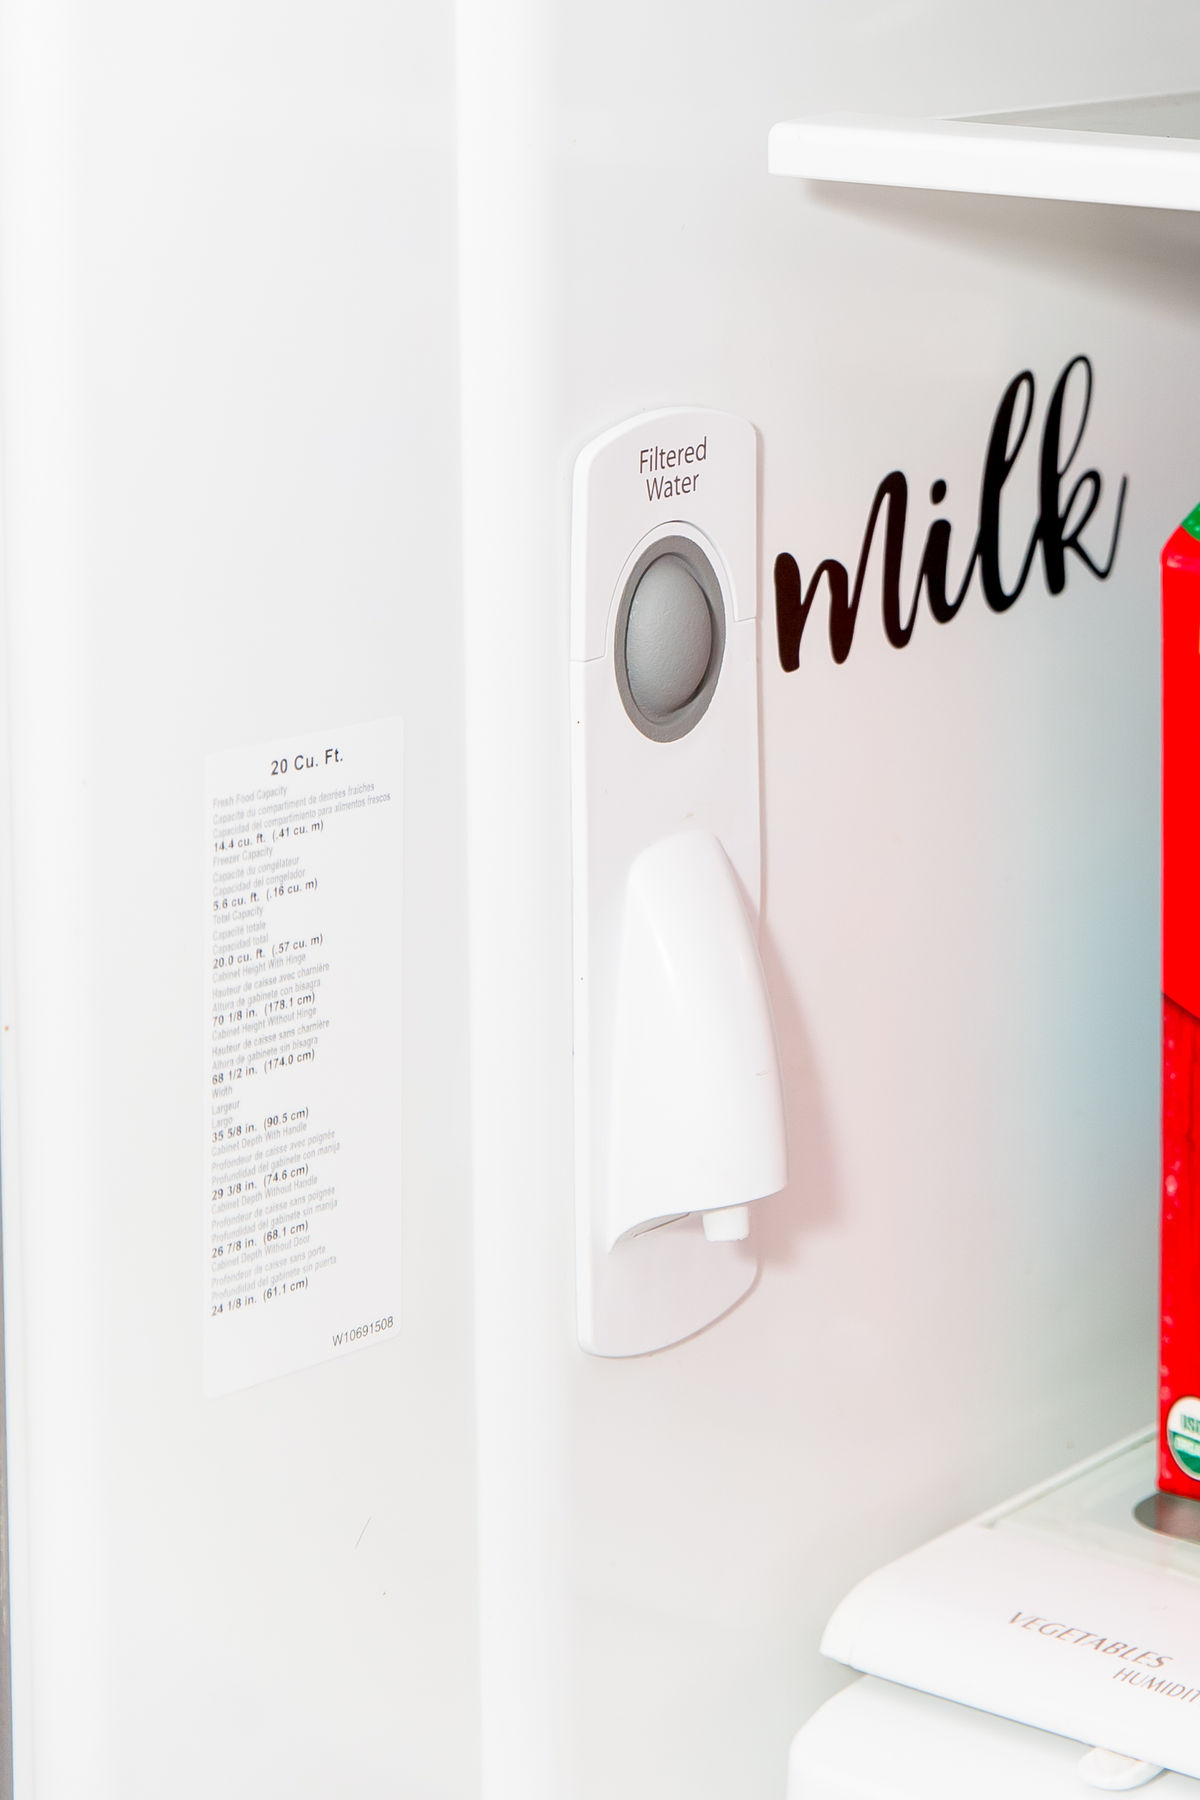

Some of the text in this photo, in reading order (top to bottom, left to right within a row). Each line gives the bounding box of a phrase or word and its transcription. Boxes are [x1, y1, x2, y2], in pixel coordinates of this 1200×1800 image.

[639, 436, 707, 474] Filtered
[646, 471, 700, 502] Water
[774, 354, 1127, 673] milk
[270, 748, 344, 777] 20 Cu. Ft.
[213, 838, 235, 854] 14.4
[237, 837, 253, 849] cu.
[293, 825, 309, 838] cu.
[311, 819, 324, 834] m)
[211, 1072, 225, 1085] 68
[296, 1048, 316, 1064] cm)
[332, 1315, 395, 1348] W10691508
[1007, 1610, 1174, 1670] VEGETABLES
